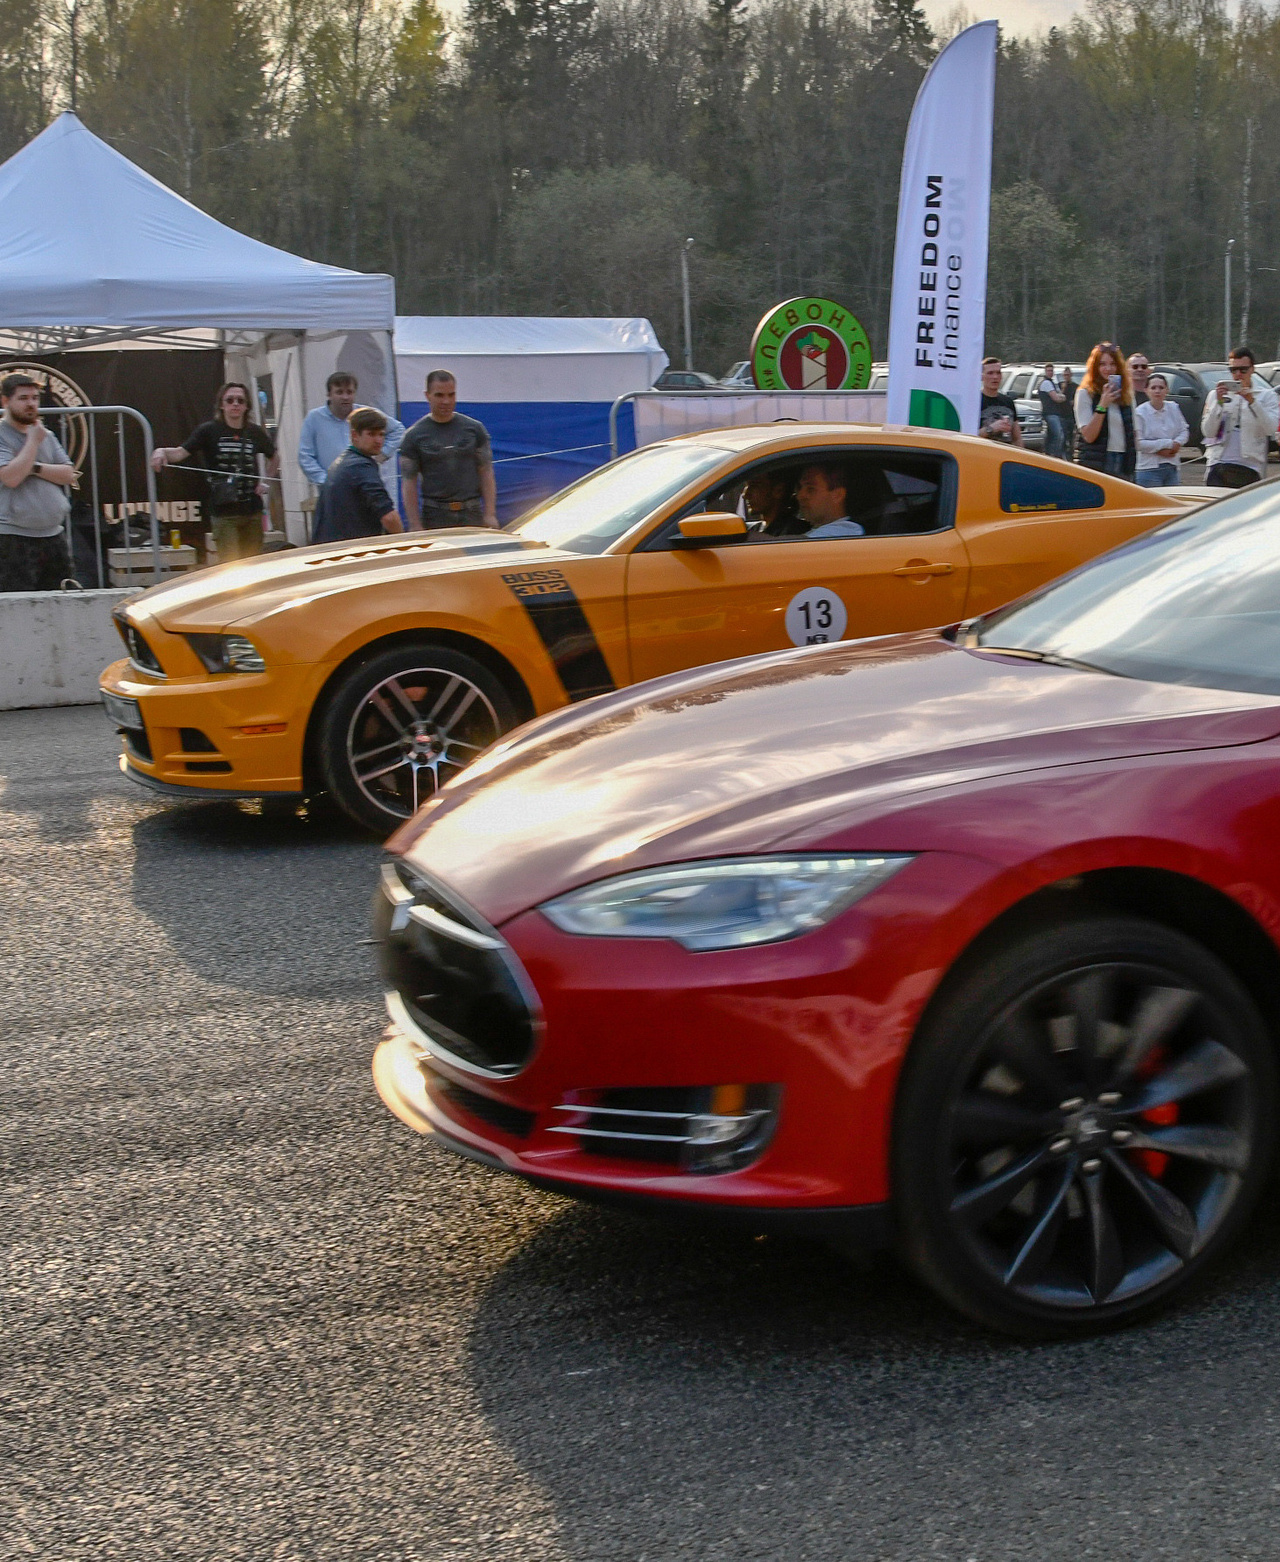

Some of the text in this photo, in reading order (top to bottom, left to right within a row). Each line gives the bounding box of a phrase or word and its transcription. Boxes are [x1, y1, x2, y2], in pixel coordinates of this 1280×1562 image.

[914, 174, 943, 368] FREEDOM
[938, 253, 963, 371] finance
[500, 568, 564, 584] BOSS
[514, 581, 571, 597] 302
[797, 599, 833, 631] 13
